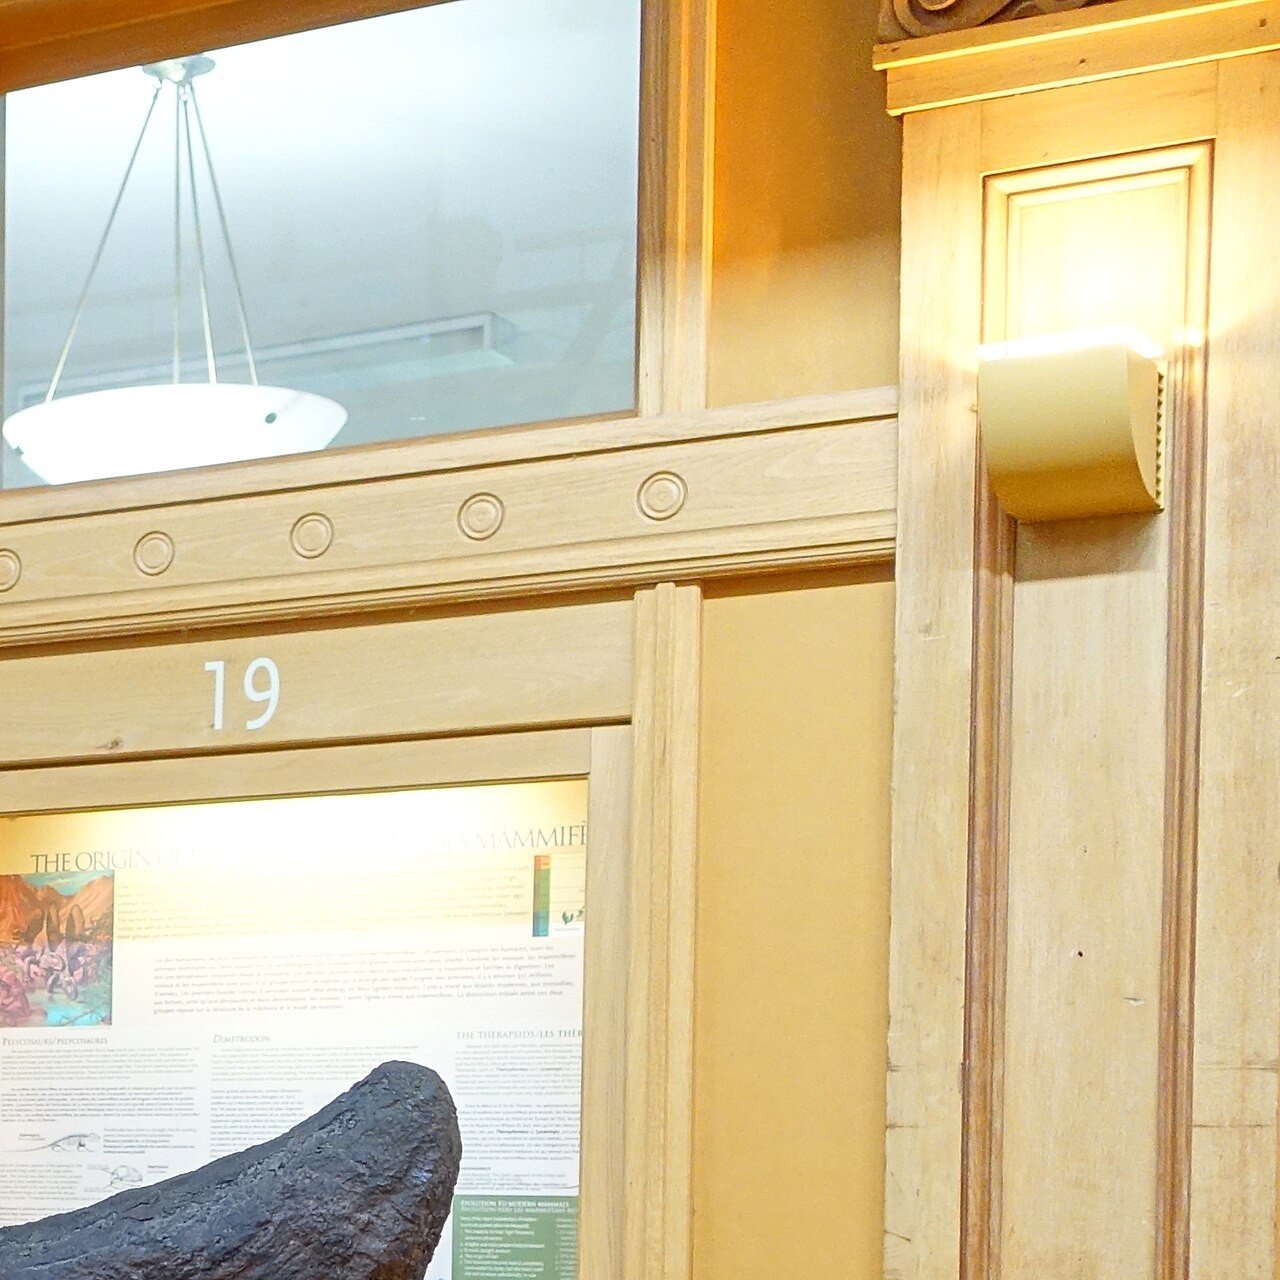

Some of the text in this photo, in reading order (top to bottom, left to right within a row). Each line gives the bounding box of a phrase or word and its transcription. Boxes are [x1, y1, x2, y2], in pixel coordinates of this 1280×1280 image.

[204, 656, 281, 730] 19
[31, 853, 71, 872] THE
[75, 851, 152, 872] ORIGIN
